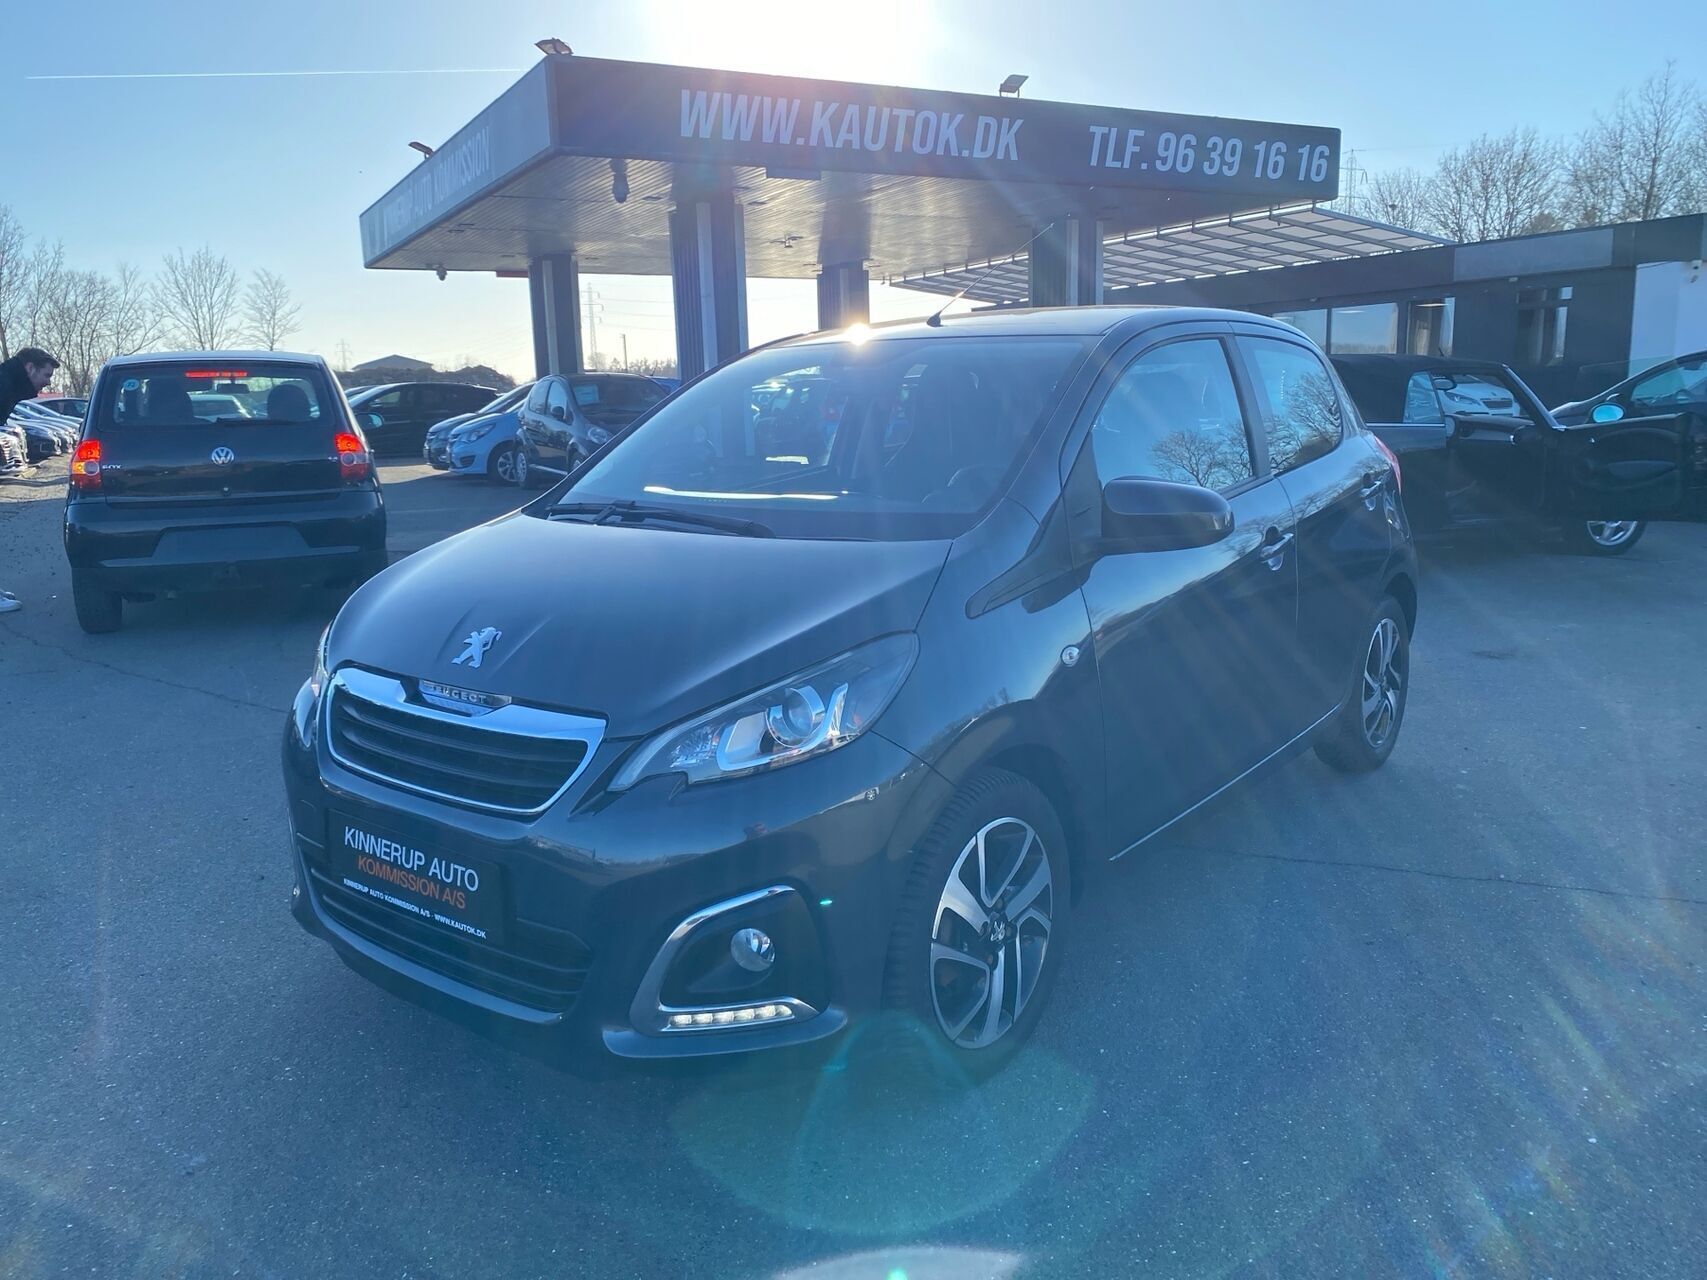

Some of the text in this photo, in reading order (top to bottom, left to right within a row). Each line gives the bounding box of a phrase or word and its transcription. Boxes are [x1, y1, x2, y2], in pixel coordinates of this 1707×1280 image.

[680, 88, 1024, 162] WWW.KAUTOK.DK
[1089, 125, 1330, 183] TLF. 96 39 16 16
[344, 825, 479, 892] KINNERUP AUTO
[358, 855, 466, 909] KOMMISSION A/S
[343, 877, 369, 894] KINNERUP
[369, 888, 384, 900] AUTO
